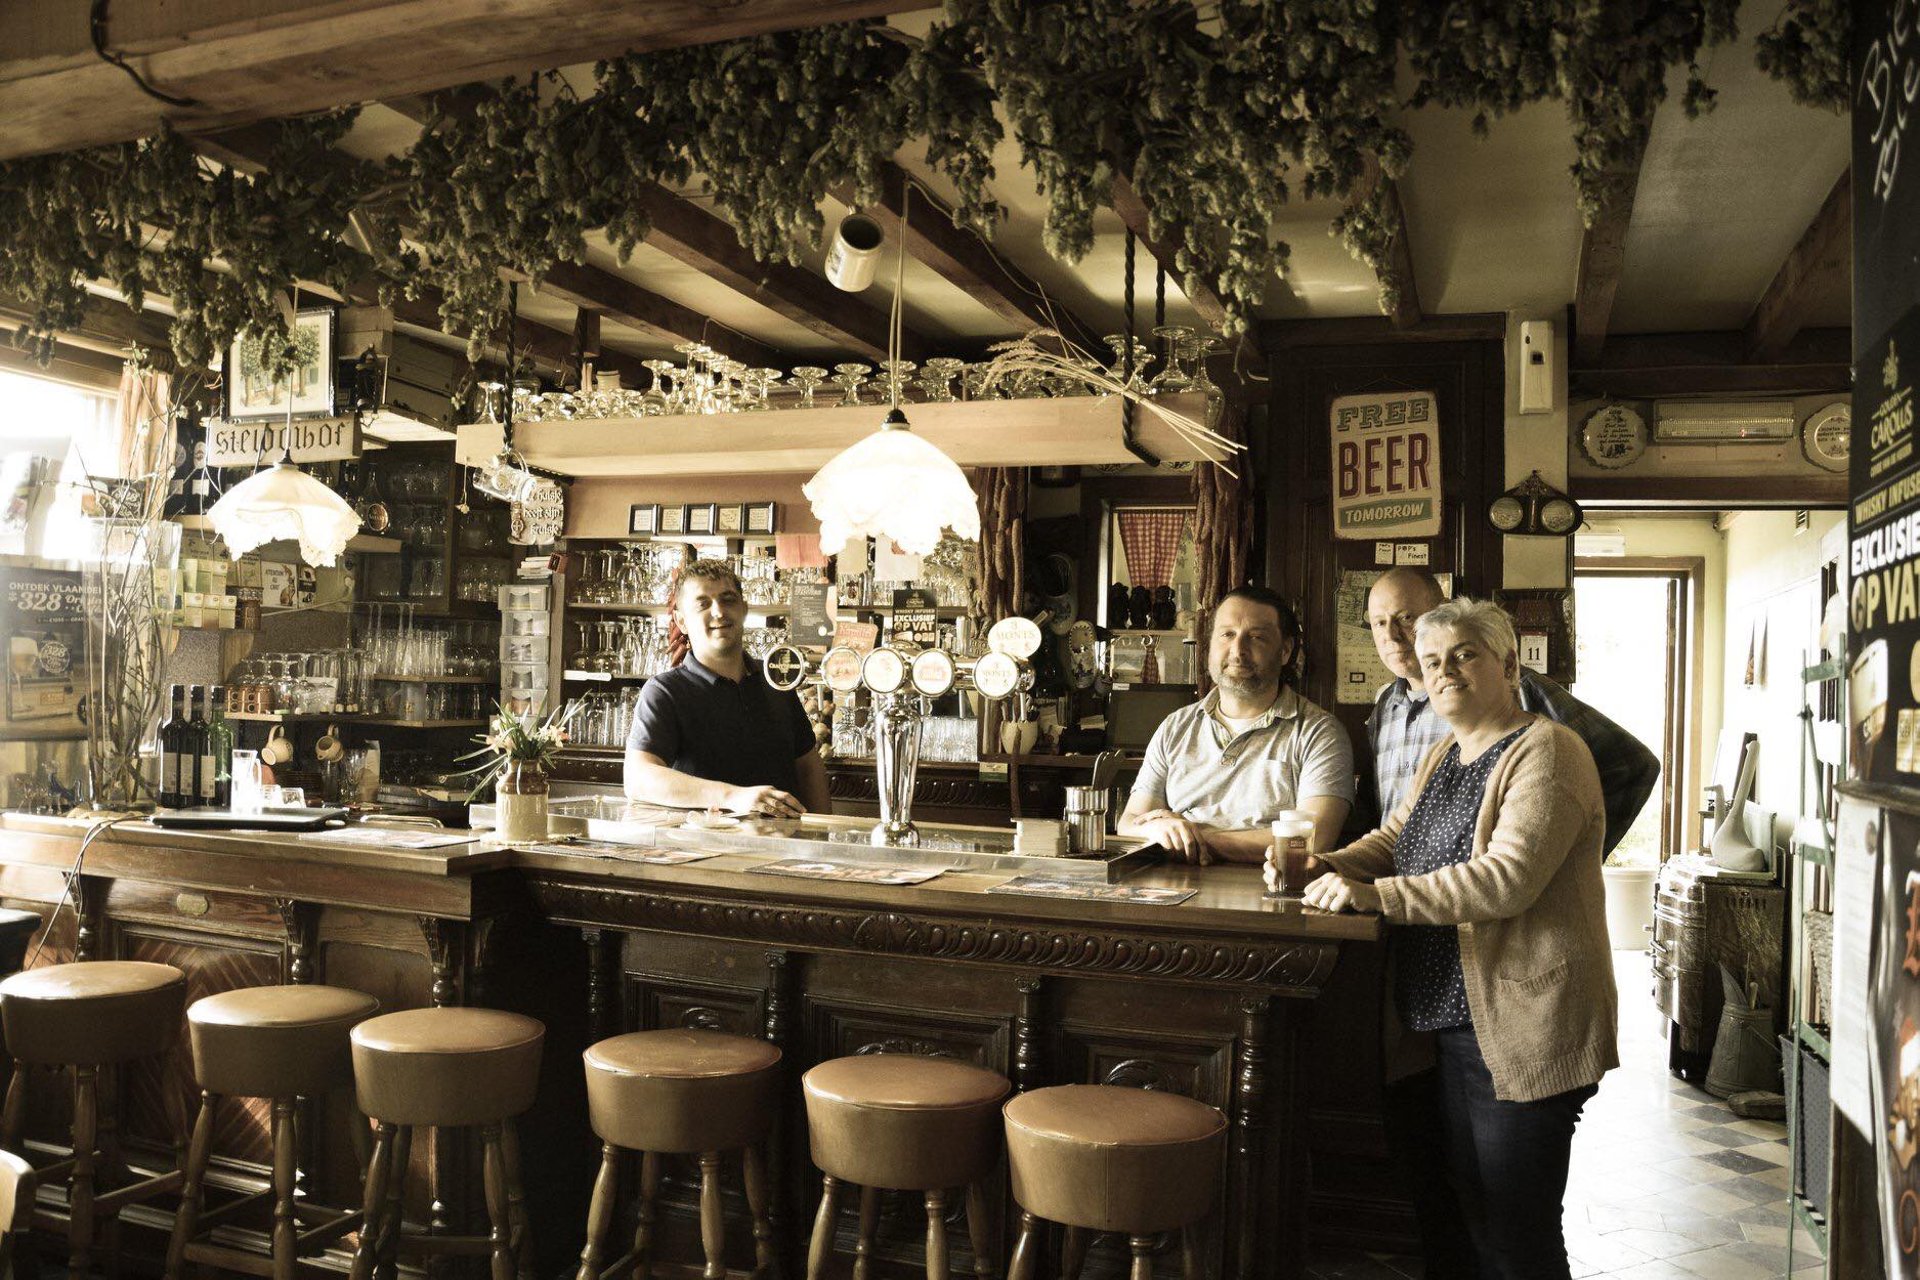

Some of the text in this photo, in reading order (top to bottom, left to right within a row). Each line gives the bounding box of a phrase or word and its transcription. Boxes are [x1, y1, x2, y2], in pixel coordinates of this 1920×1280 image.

[1336, 398, 1429, 432] FREE
[1871, 399, 1913, 450] CAROLUS
[1339, 433, 1431, 499] BEER
[1346, 503, 1424, 523] TOMORROW
[1855, 487, 1887, 524] WHISKY
[9, 582, 50, 593] ONTDEK
[17, 591, 62, 612] 328
[894, 614, 935, 622] EXCLUSIEF
[912, 621, 934, 631] VAT
[1528, 647, 1540, 660] 11
